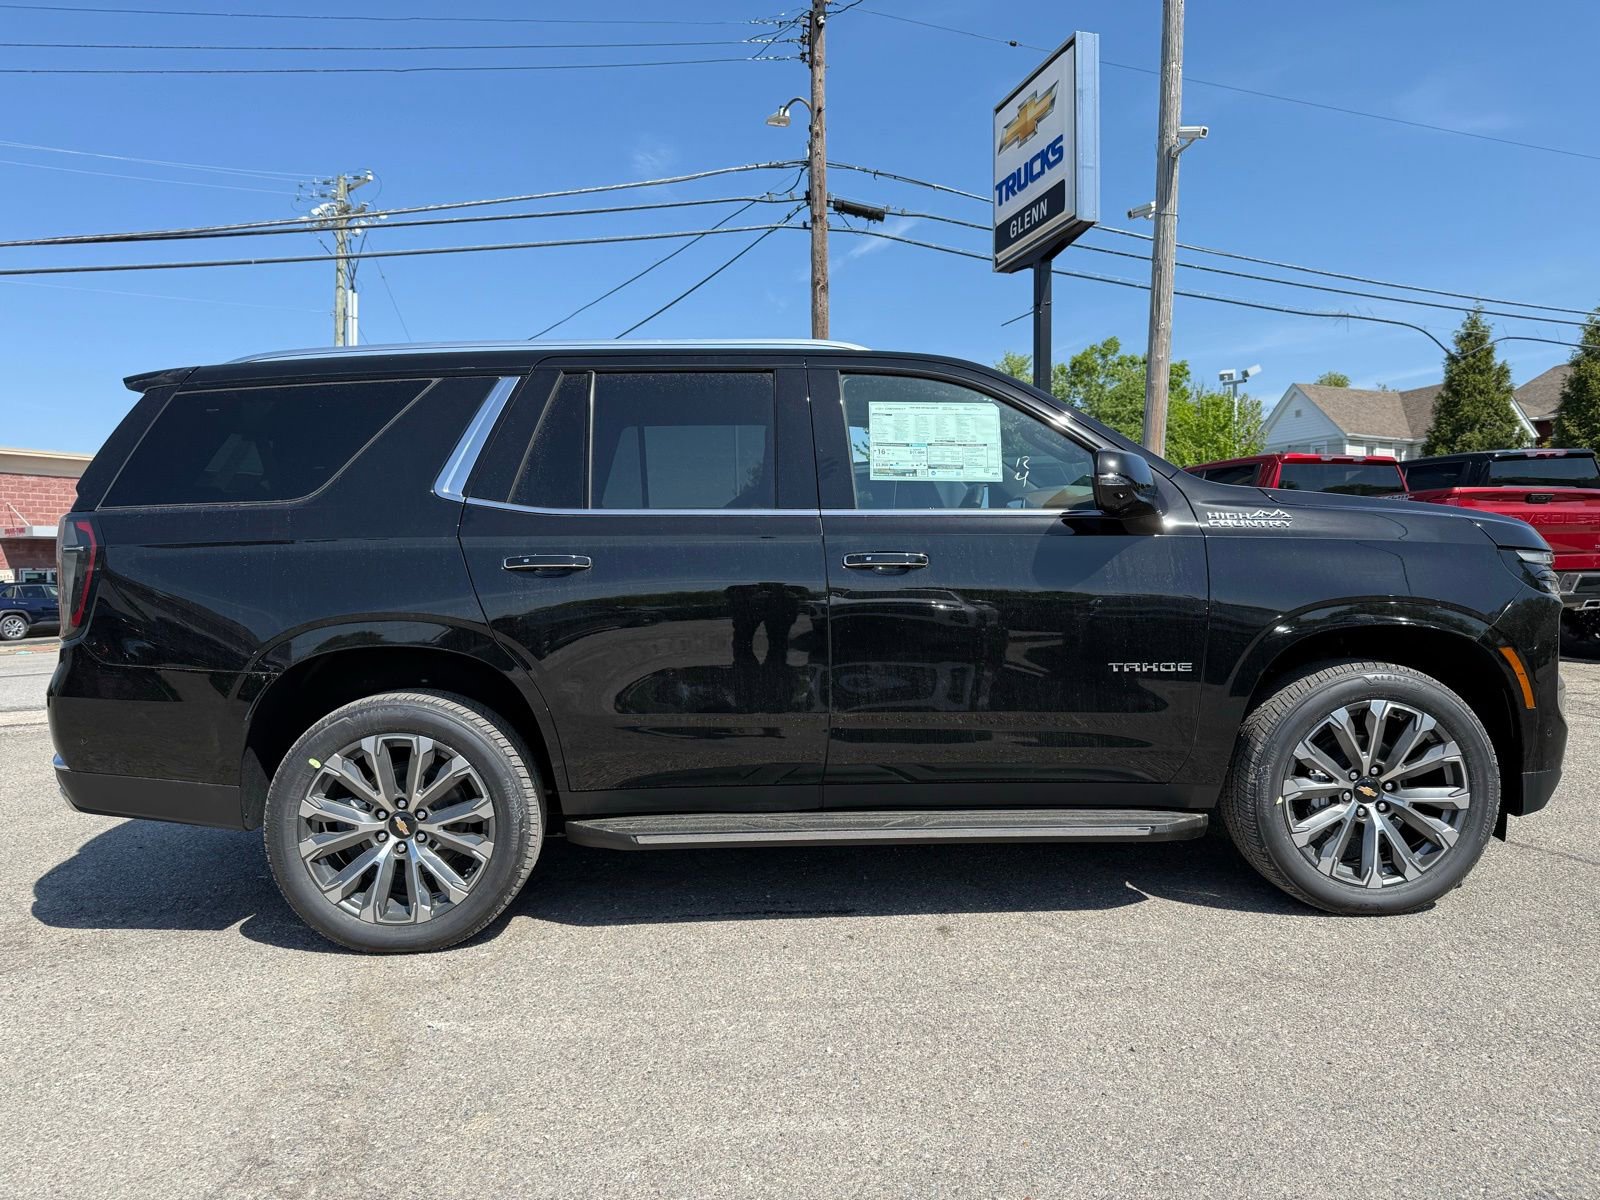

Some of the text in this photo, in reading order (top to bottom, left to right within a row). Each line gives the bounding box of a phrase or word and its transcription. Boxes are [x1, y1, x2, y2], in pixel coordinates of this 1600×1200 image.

[995, 134, 1064, 207] TRUCKS
[1009, 198, 1048, 239] GLENN
[1014, 471, 1030, 488] 4
[1207, 511, 1250, 520] HIGH
[1208, 519, 1293, 529] COUNTRY
[1107, 662, 1193, 673] TAHOE
